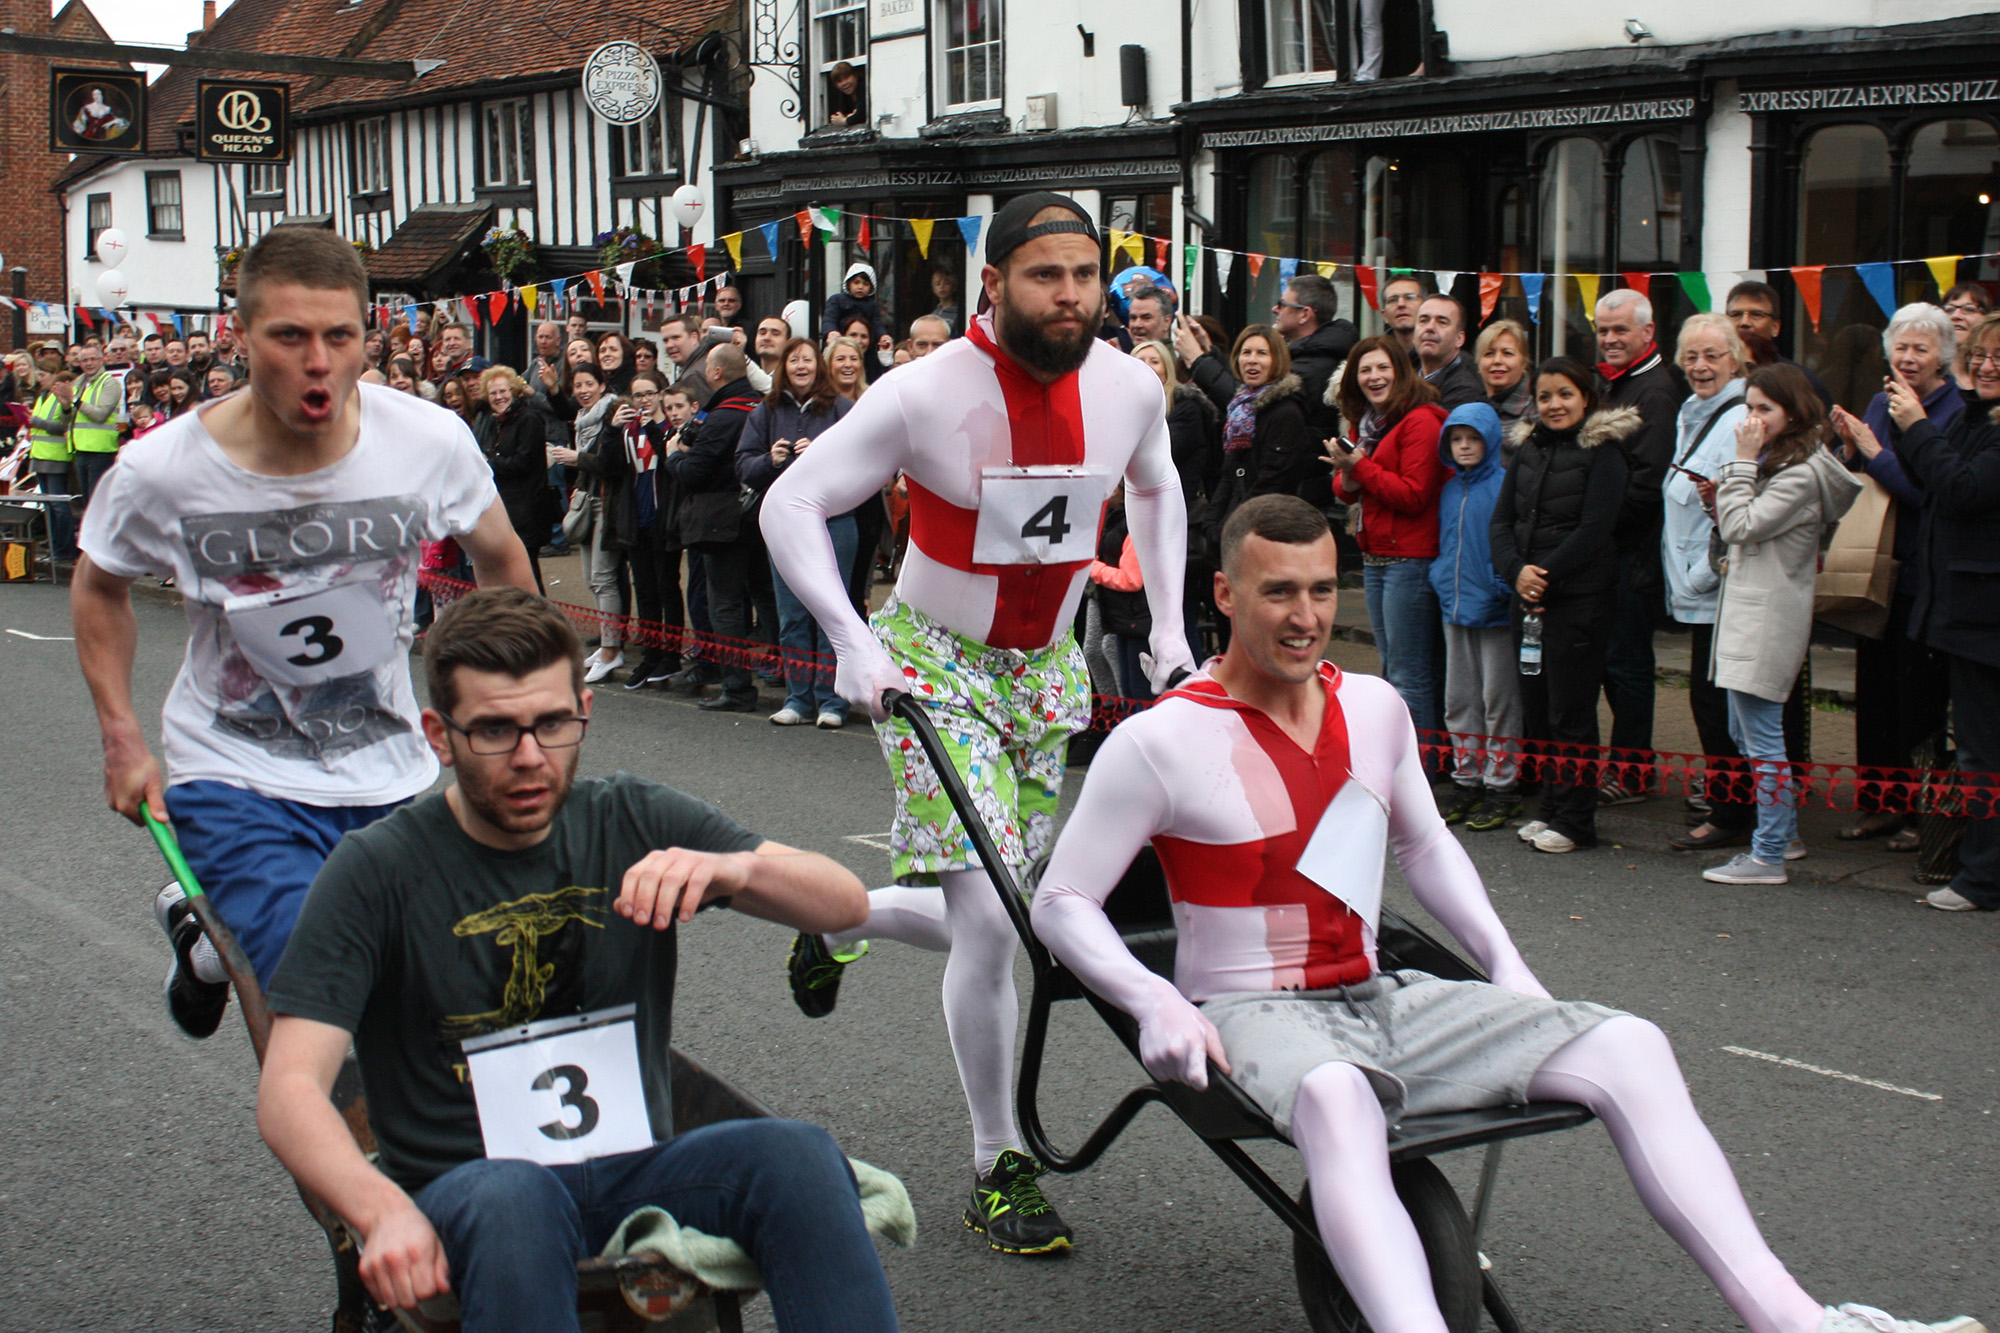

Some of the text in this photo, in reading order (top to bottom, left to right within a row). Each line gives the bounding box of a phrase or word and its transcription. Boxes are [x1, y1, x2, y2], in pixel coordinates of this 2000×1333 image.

[596, 80, 649, 93] EXPRESS
[605, 70, 640, 81] PIZZA
[211, 134, 275, 145] QUEEN'S
[222, 143, 264, 154] HEAD
[1021, 494, 1071, 545] 4
[199, 510, 416, 566] GLORY
[279, 615, 344, 667] 3
[531, 1064, 600, 1141] 3
